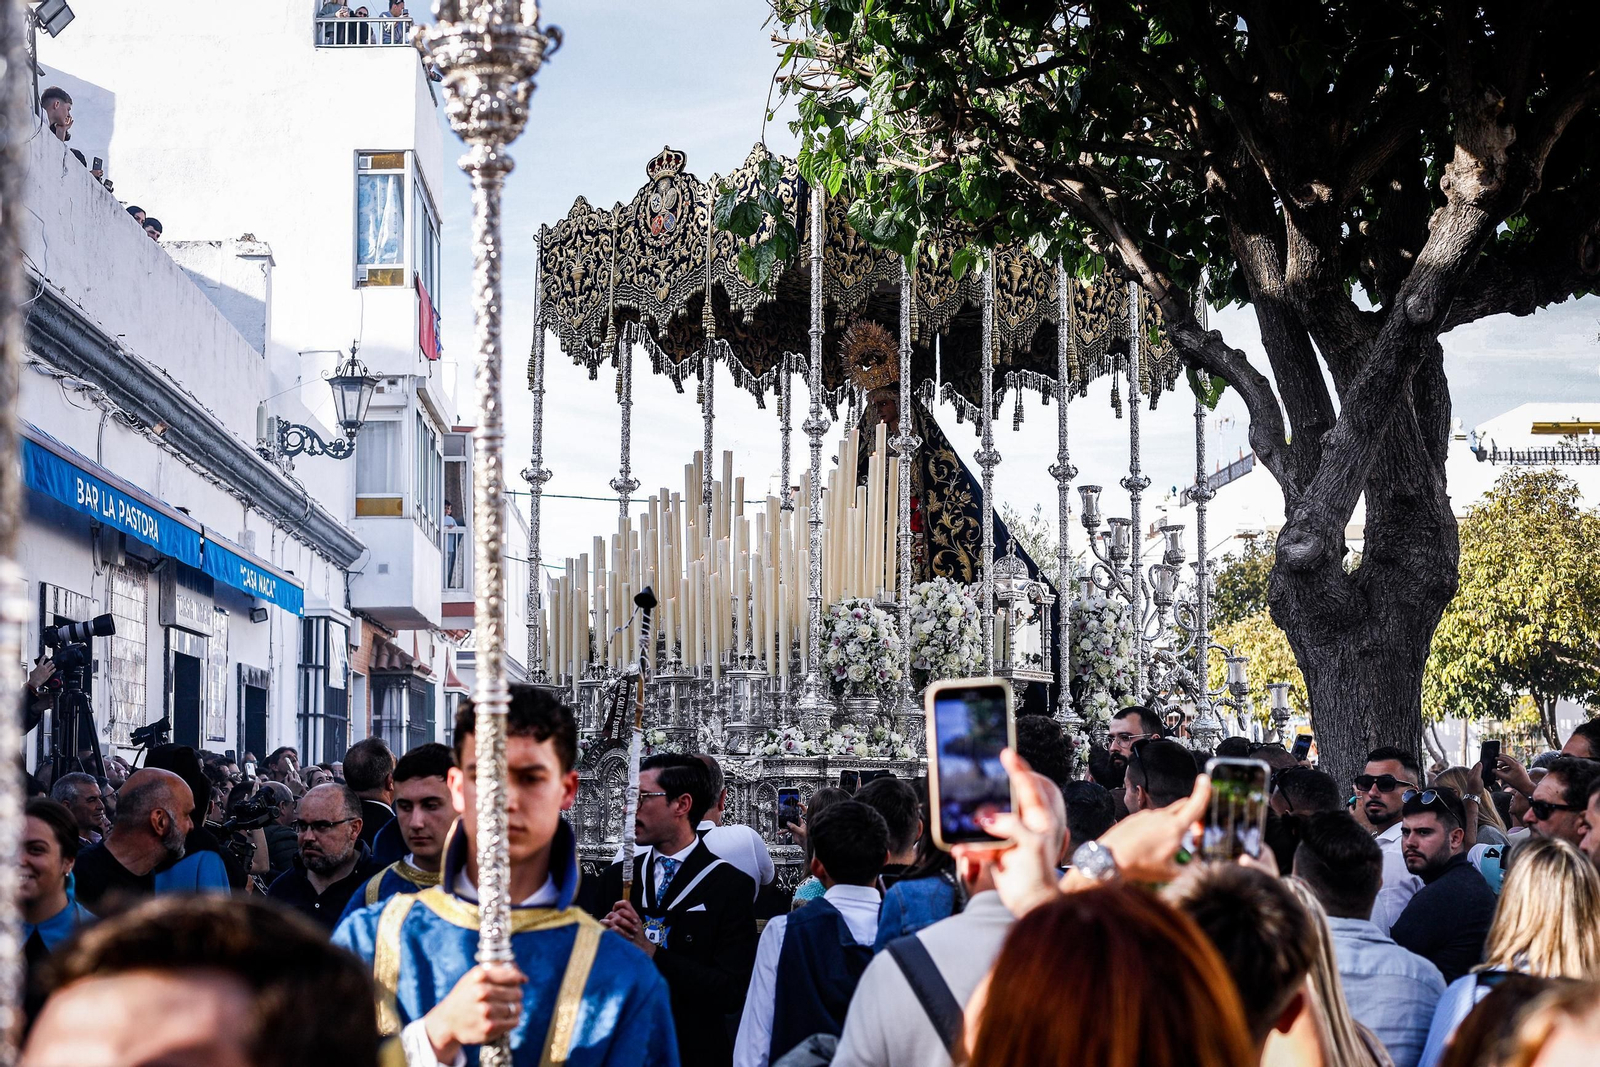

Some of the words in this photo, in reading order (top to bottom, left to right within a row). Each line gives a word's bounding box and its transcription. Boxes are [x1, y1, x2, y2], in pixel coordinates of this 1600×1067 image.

[77, 477, 98, 512] BAR
[102, 490, 116, 520] LA
[119, 499, 159, 543] PASTORA
